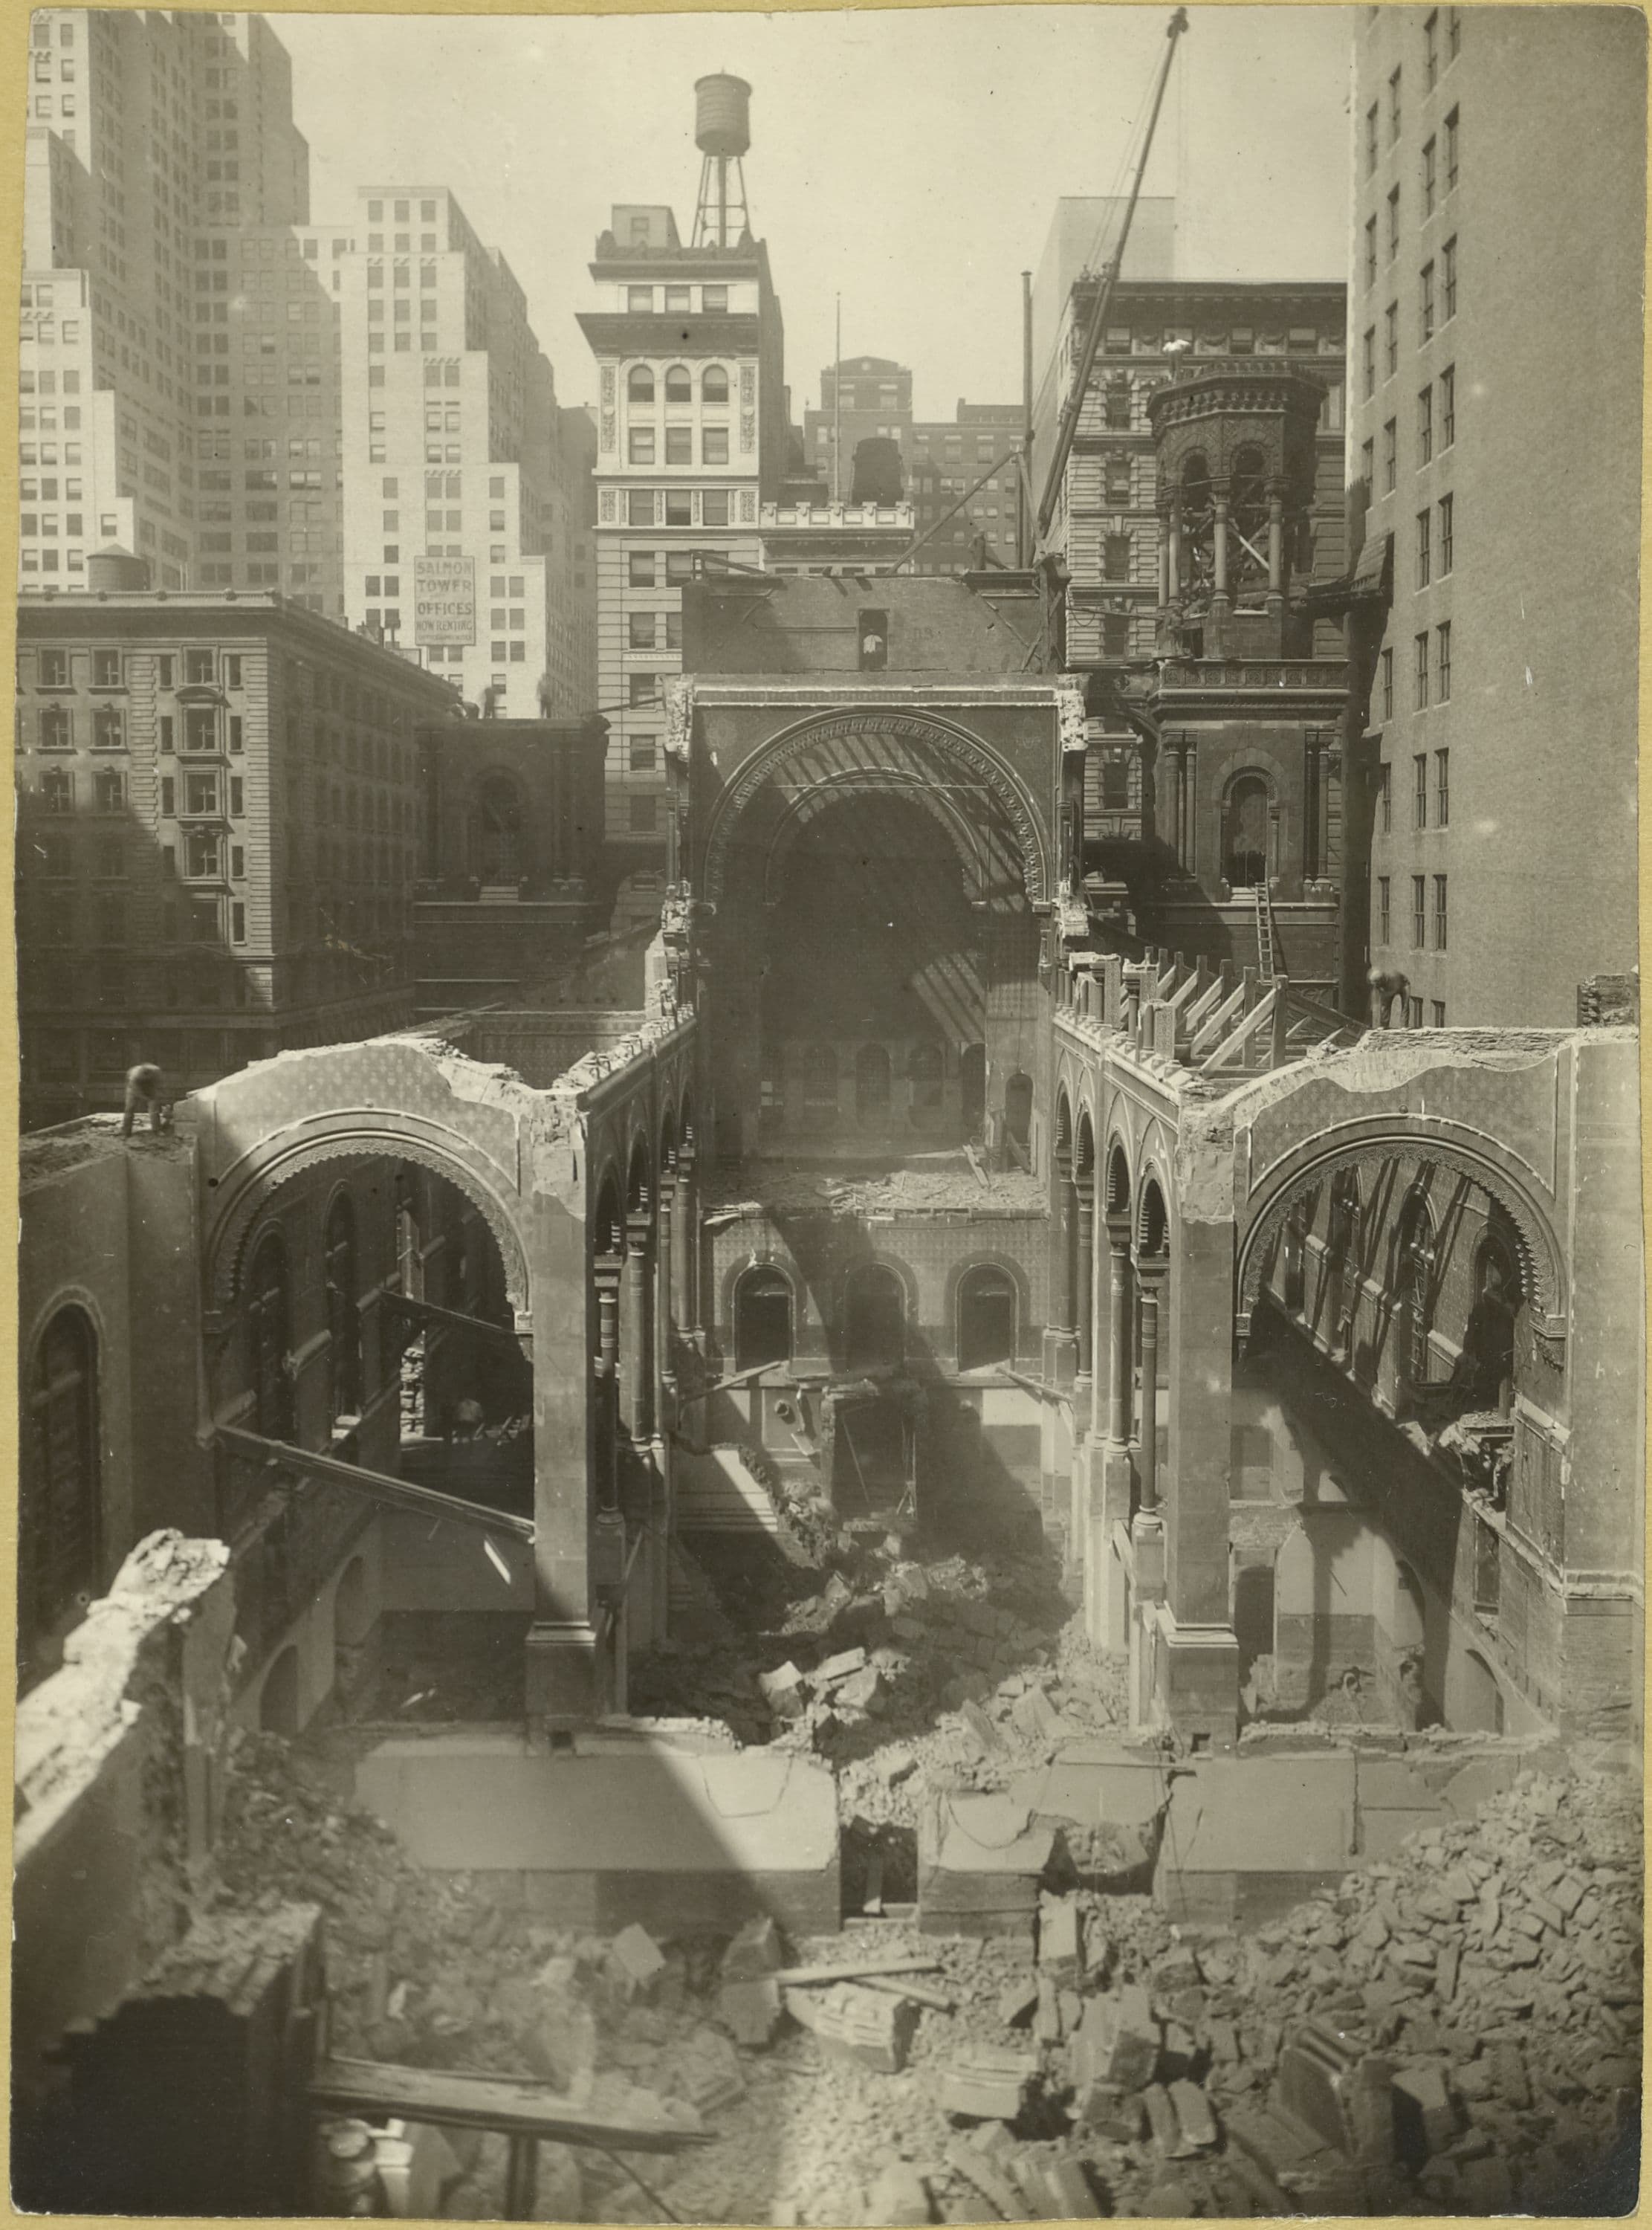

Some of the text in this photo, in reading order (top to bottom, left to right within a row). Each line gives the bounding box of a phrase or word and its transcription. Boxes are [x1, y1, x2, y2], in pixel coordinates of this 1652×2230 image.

[416, 562, 472, 575] SALMON
[416, 580, 472, 592] TOWER
[418, 602, 473, 615] OFFICES
[436, 620, 473, 630] RENTING
